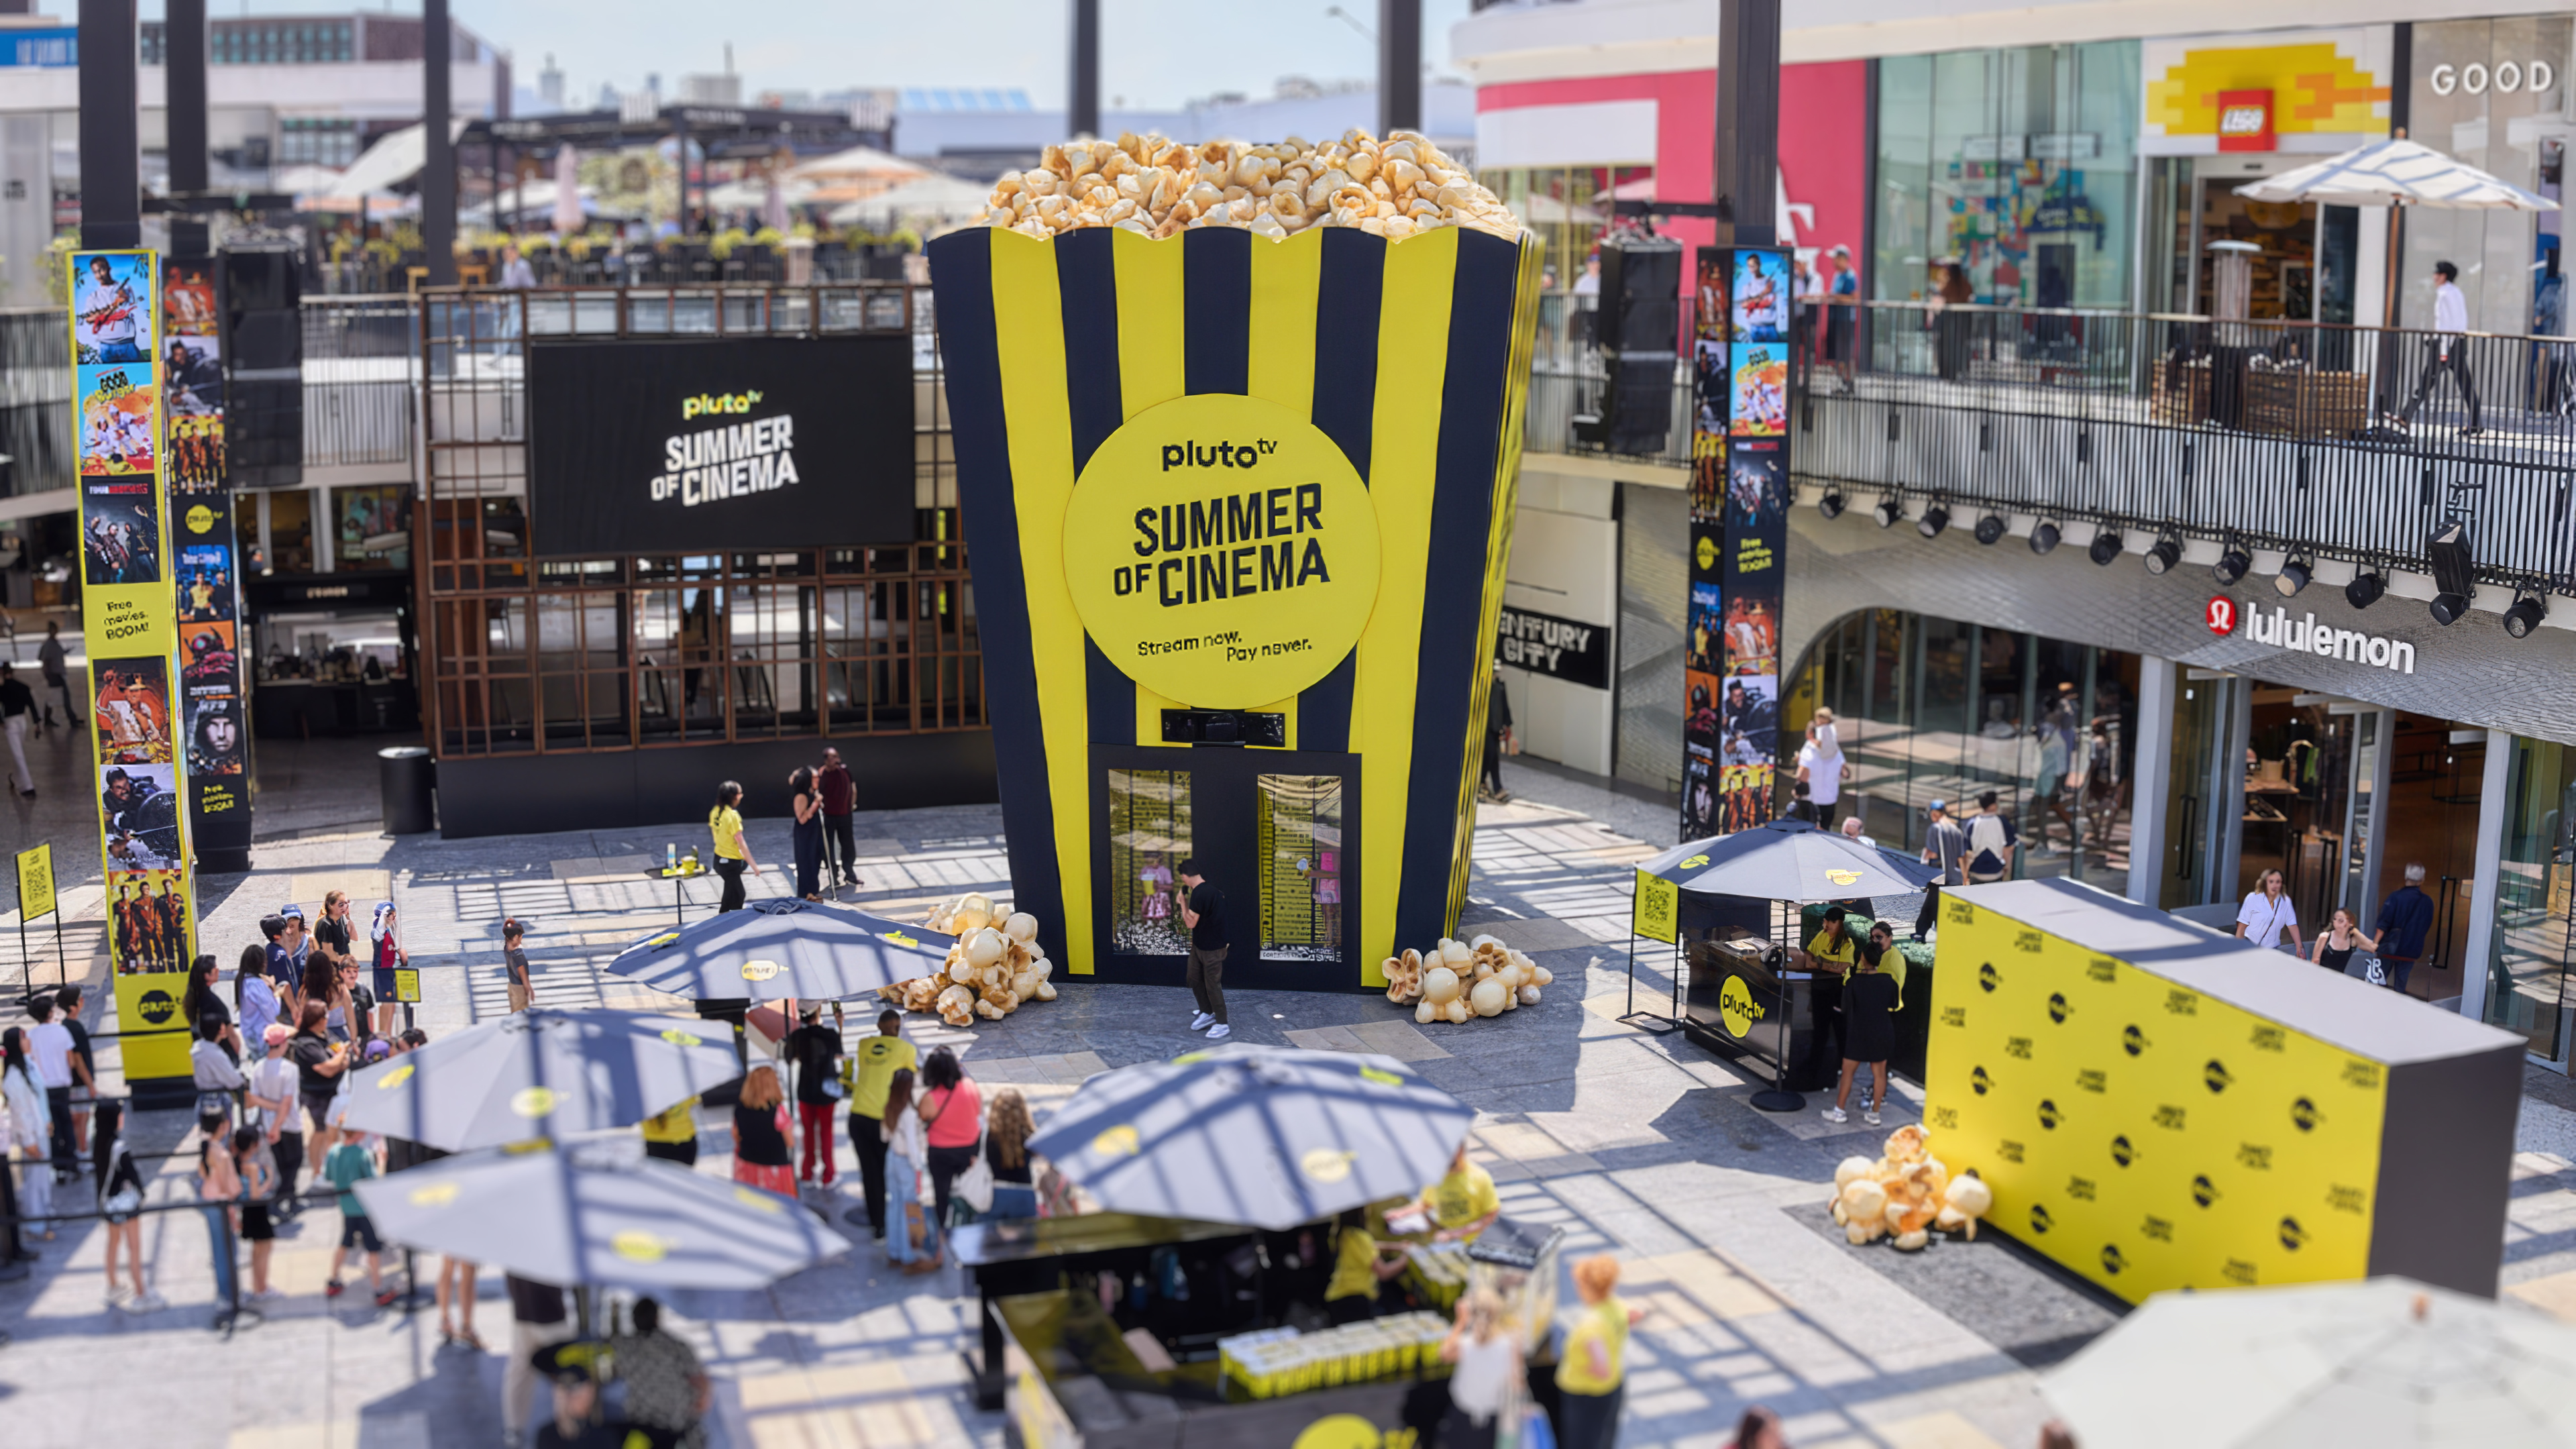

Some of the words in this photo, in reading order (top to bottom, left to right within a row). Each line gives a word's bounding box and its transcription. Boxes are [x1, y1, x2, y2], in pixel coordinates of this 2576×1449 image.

[2431, 60, 2553, 96] GOOD
[2219, 107, 2265, 134] LEGO
[665, 414, 794, 472] SUMMER
[651, 473, 680, 501] OF
[682, 449, 800, 506] CINEMA
[1134, 483, 1324, 556] SUMMER
[1113, 564, 1152, 596] OF
[1159, 537, 1331, 607] CINEMA
[1138, 637, 1199, 656] Stream
[1203, 631, 1242, 648] now.
[1227, 646, 1257, 663] Pay
[1262, 639, 1312, 656] never.
[1503, 637, 1562, 672] CITY
[2246, 602, 2414, 674] lululemon
